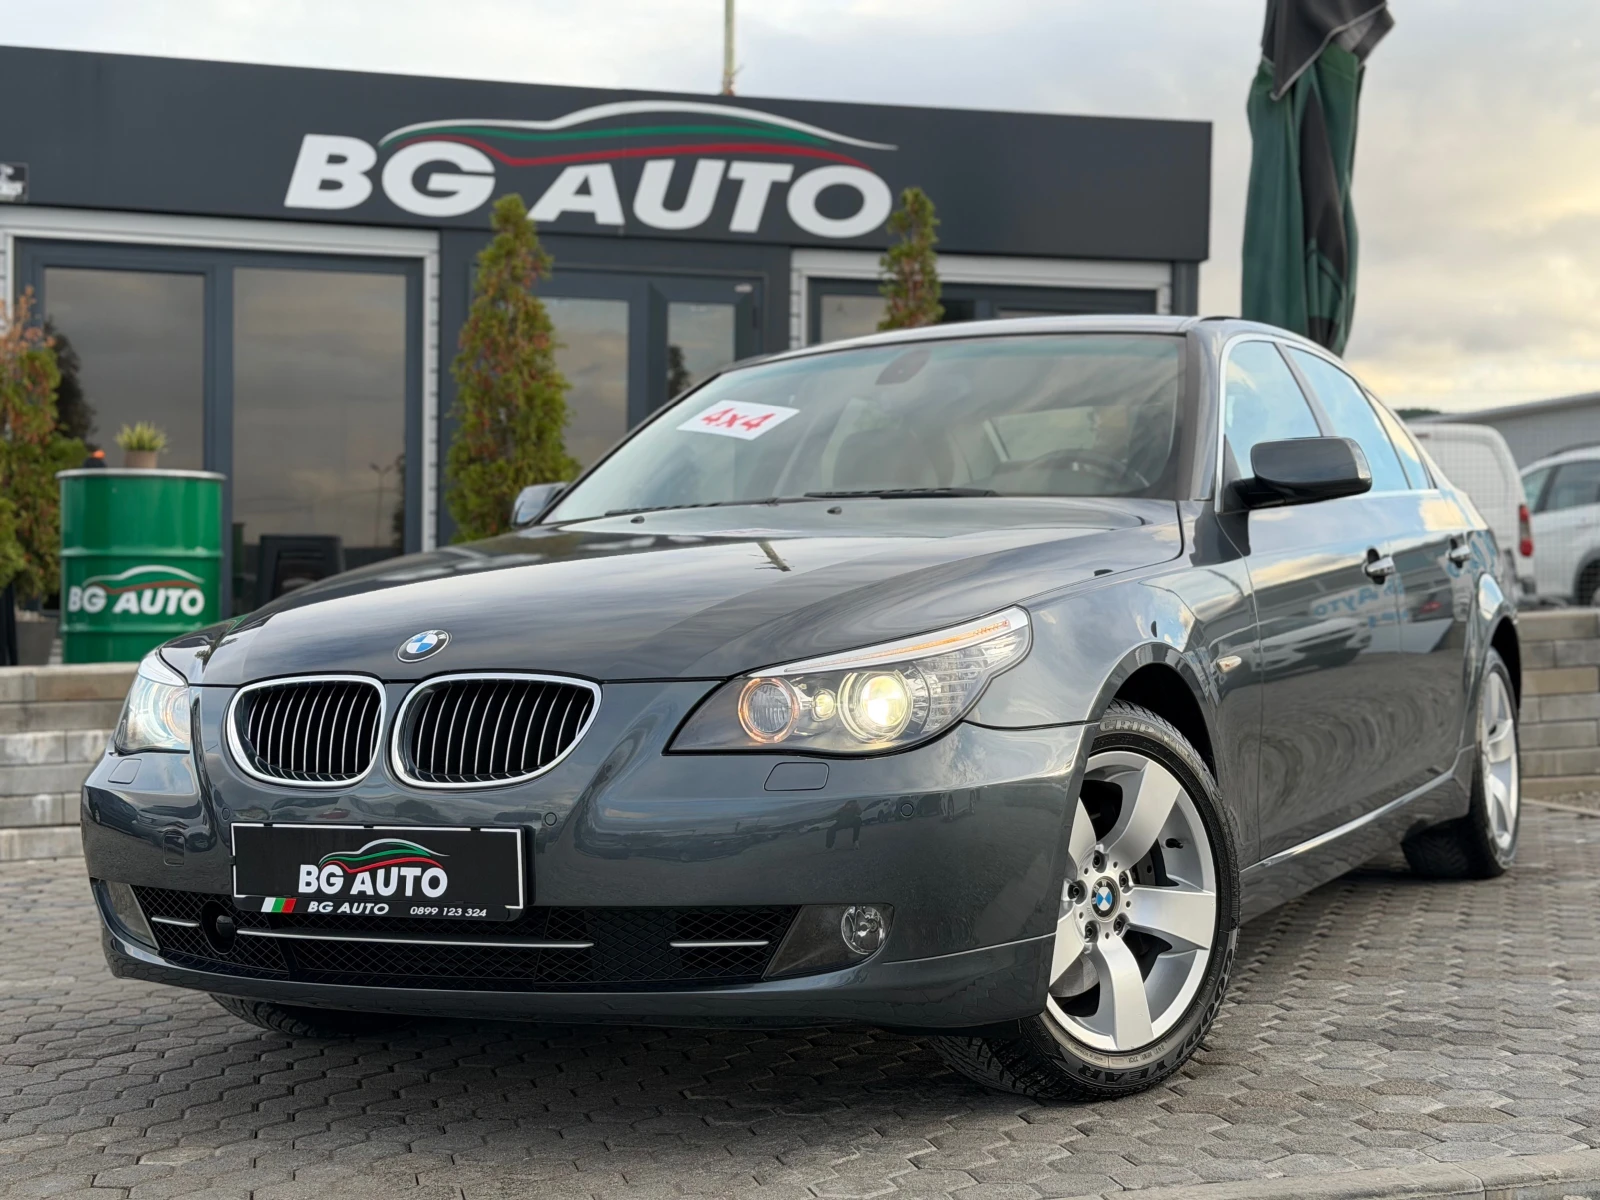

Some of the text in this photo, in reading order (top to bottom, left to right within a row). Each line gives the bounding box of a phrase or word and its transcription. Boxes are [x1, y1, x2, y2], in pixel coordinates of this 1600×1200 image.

[284, 134, 893, 239] BG AUTO
[701, 407, 776, 431] 4x4
[68, 585, 205, 616] BG AUTO
[298, 864, 448, 898] BG AUTO
[307, 901, 389, 915] BG AUTO
[410, 906, 487, 917] 0899 123 324
